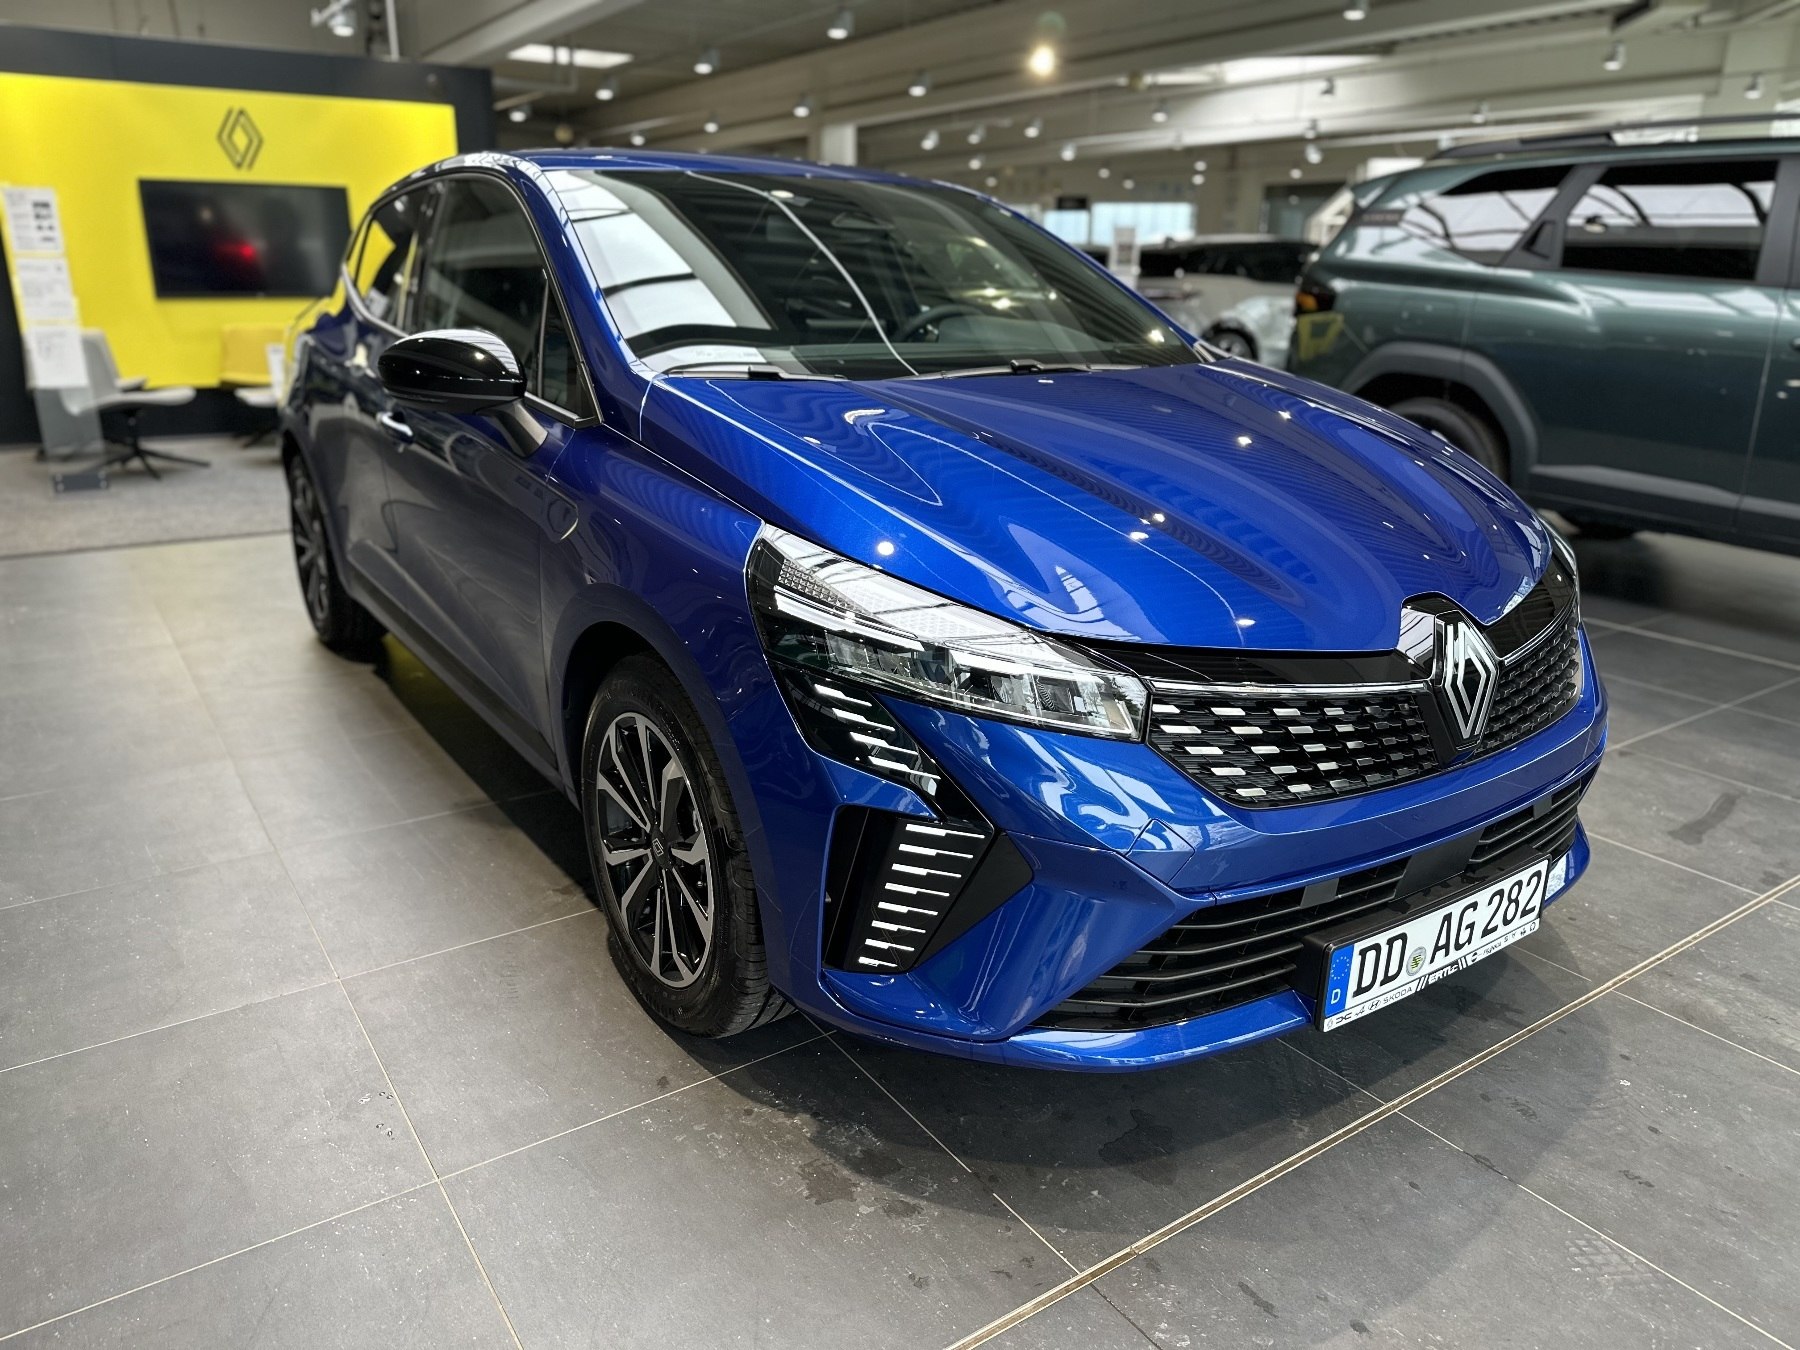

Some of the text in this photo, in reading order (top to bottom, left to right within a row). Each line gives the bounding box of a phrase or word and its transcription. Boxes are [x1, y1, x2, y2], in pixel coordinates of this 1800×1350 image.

[1330, 869, 1542, 1005] D DD AG 282
